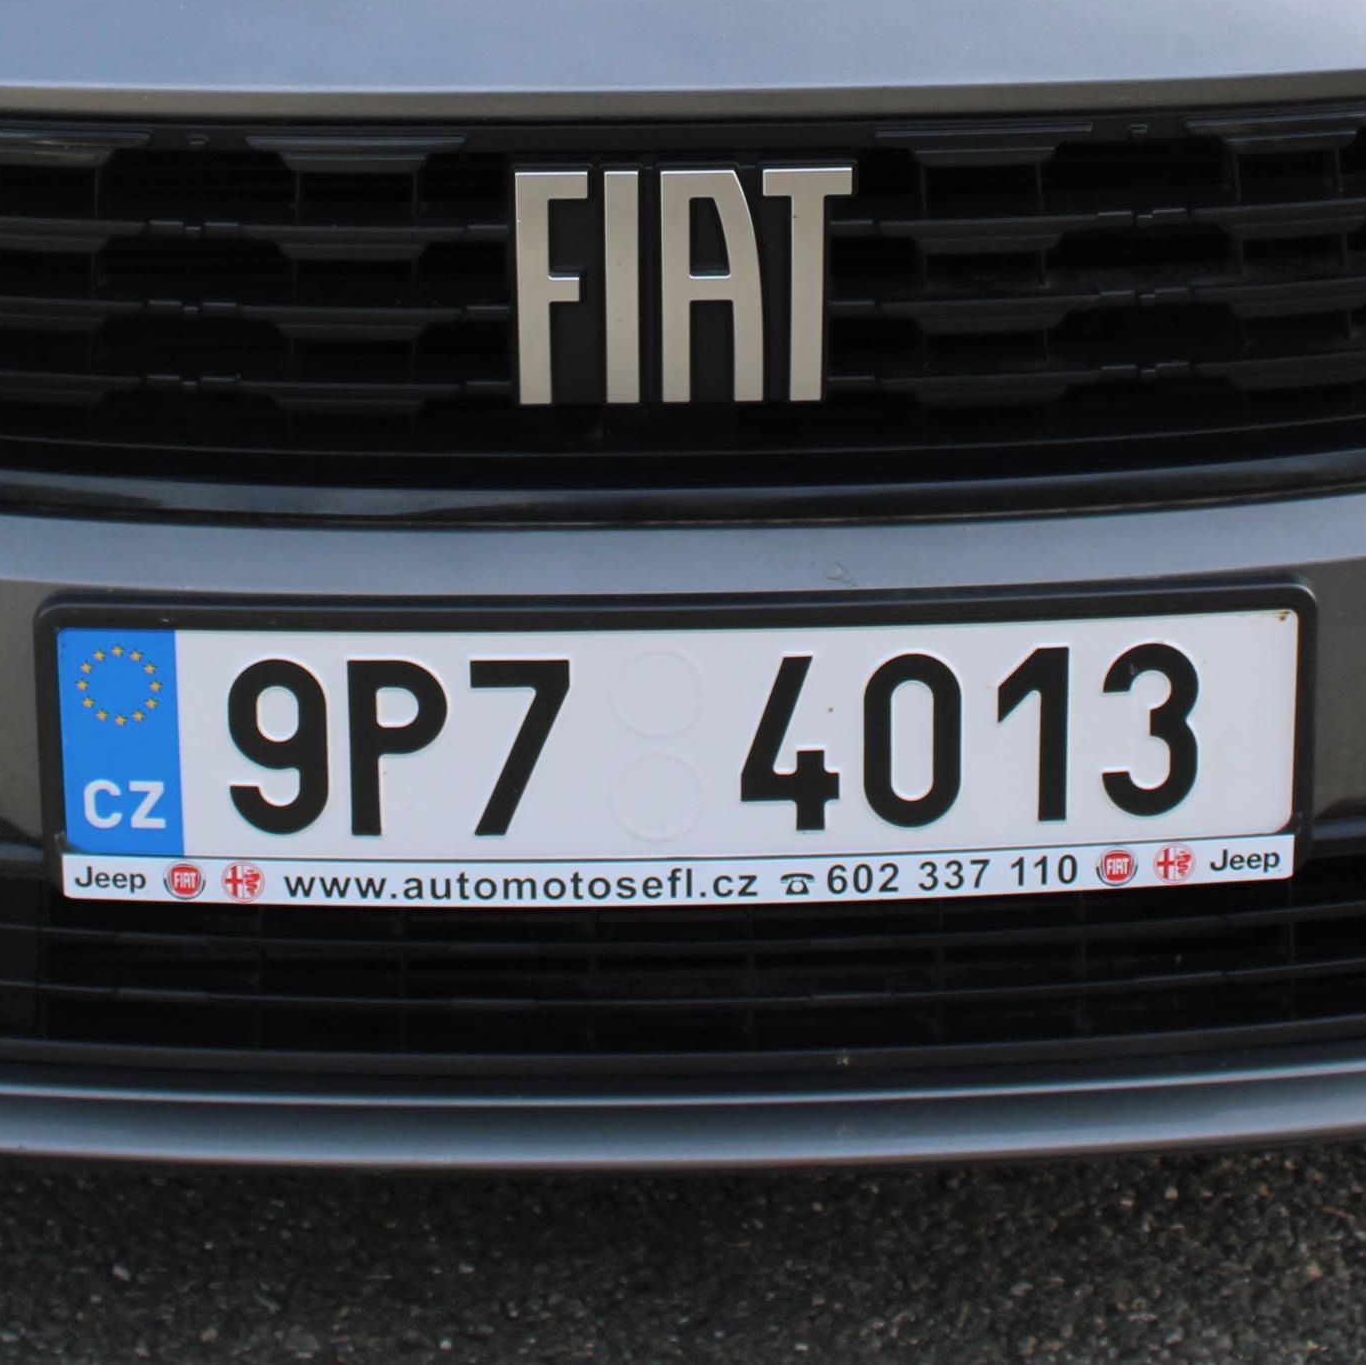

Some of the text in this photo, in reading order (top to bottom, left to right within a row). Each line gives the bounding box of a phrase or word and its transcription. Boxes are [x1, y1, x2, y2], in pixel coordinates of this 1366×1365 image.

[515, 167, 853, 405] FIAT
[227, 642, 1200, 837] 9P7 4013
[83, 779, 166, 830] CZ
[284, 853, 1078, 900] www.automotosefl.cz 602 337 110
[1106, 856, 1130, 877] FIAT
[1209, 848, 1281, 873] Jeep
[74, 866, 146, 893] Jeep
[173, 871, 197, 888] FIAT
